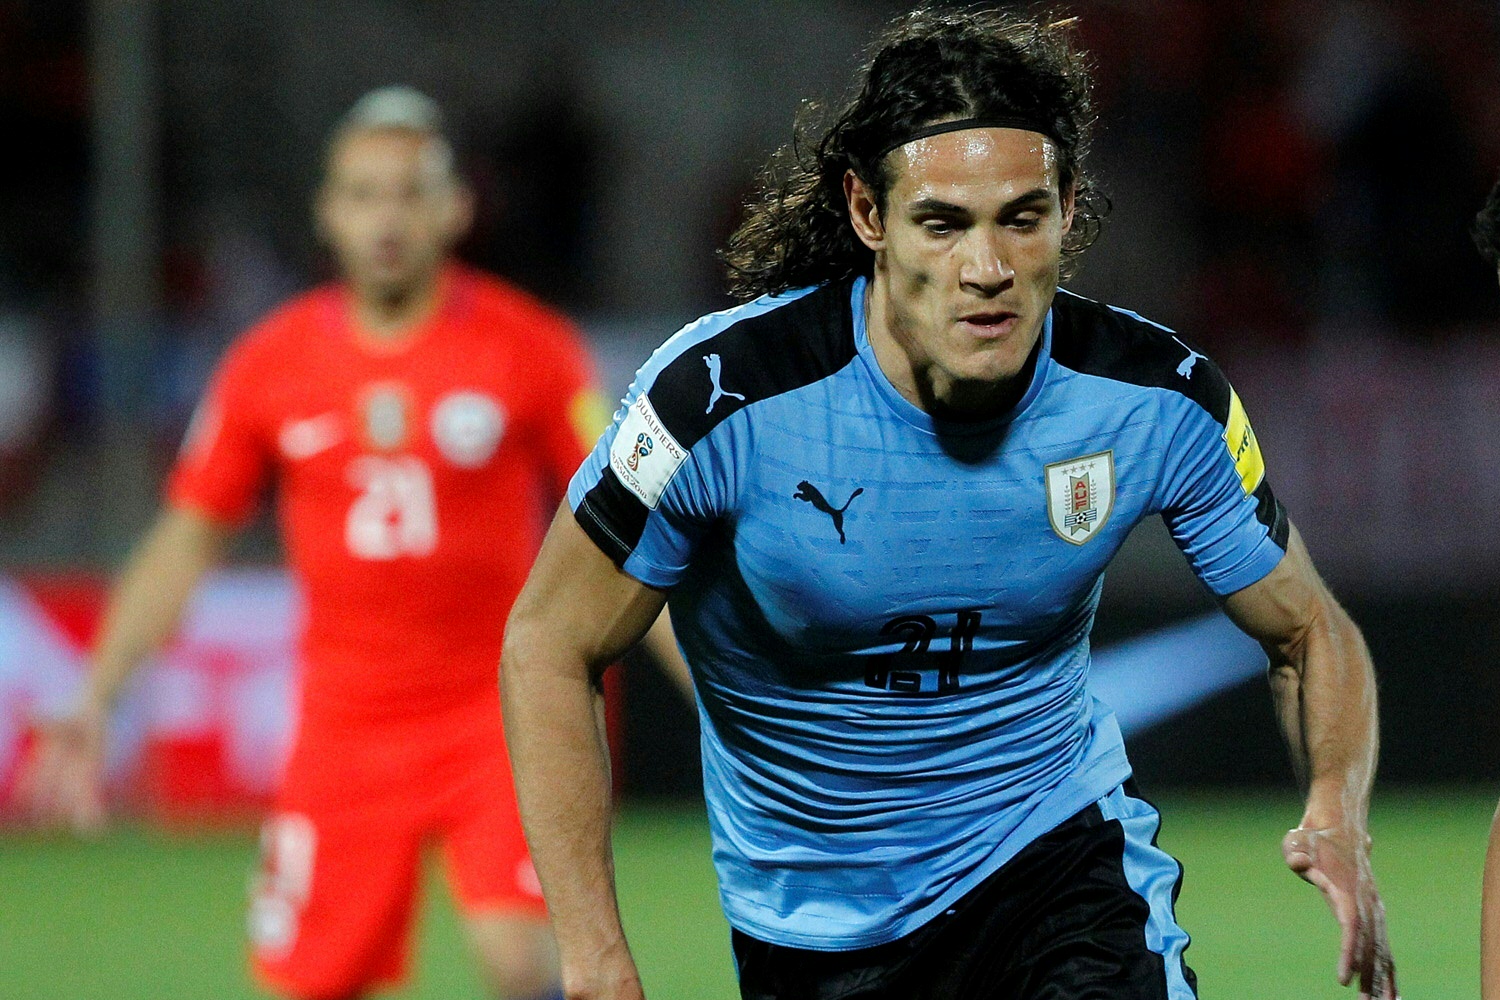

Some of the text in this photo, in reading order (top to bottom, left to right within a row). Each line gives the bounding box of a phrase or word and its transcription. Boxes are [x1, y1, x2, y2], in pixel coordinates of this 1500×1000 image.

[635, 397, 681, 460] QUALIFIERS
[1074, 481, 1088, 510] AUF
[864, 610, 982, 693] 21
